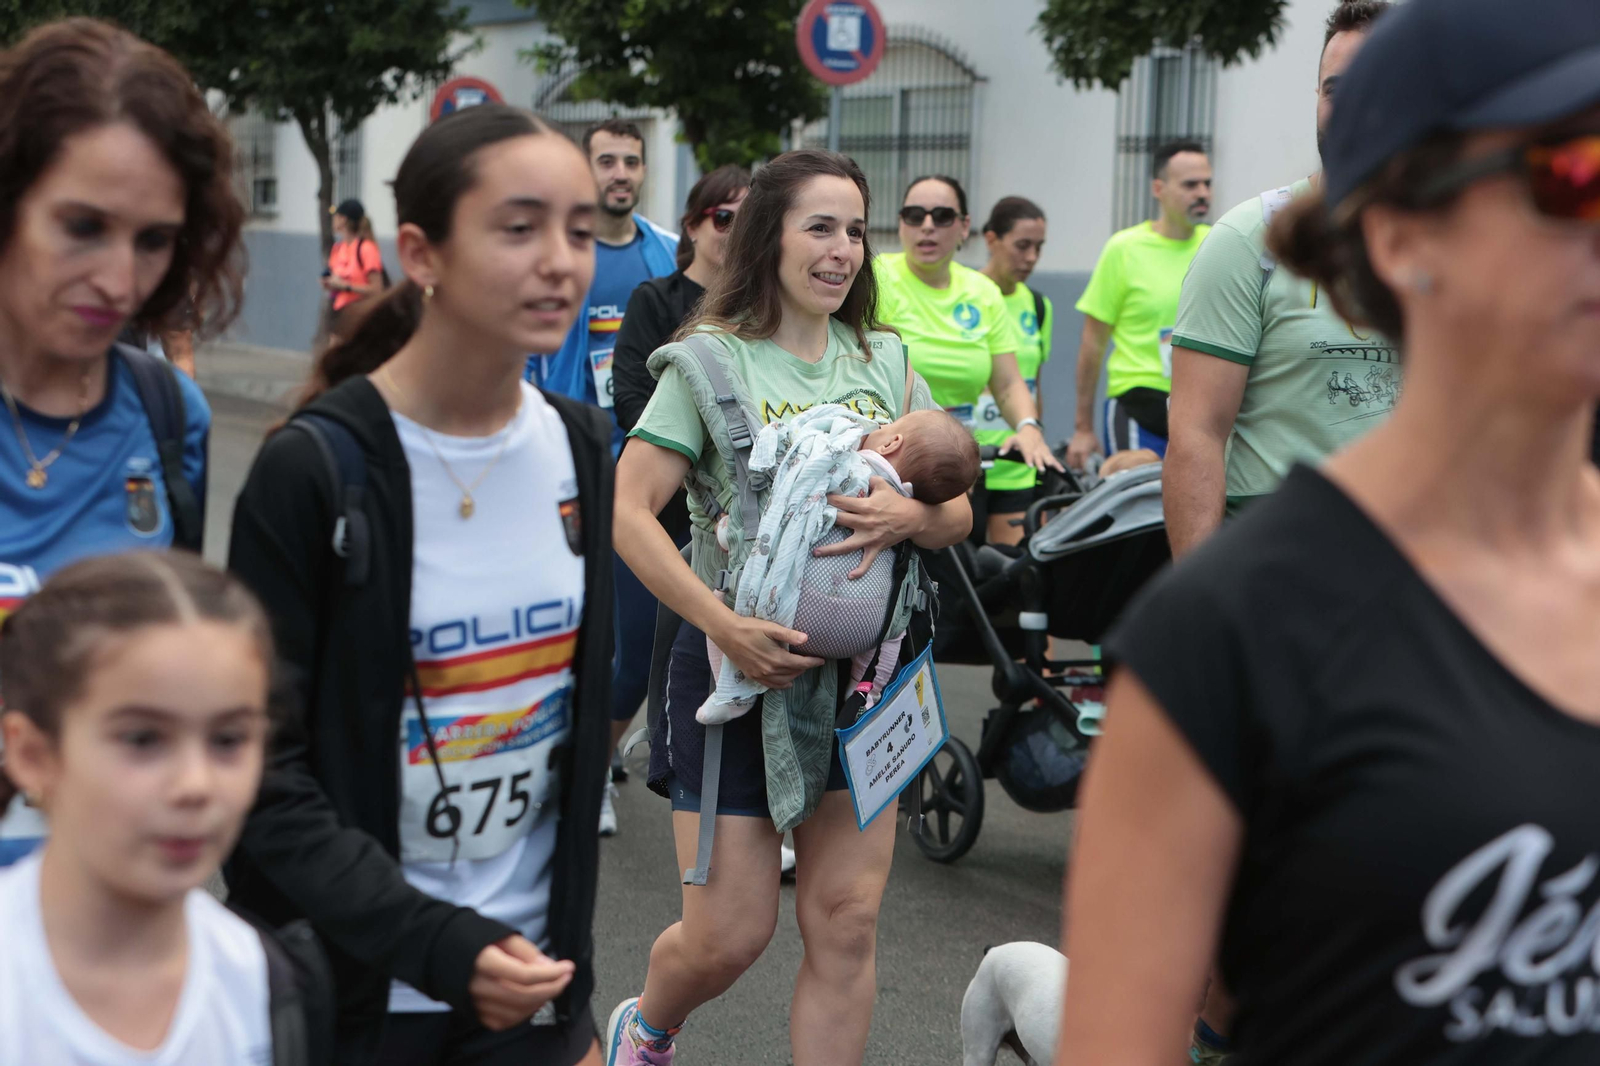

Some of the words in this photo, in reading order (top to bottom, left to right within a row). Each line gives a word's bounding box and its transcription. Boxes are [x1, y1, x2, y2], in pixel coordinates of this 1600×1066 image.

[1310, 341, 1327, 349] 2025
[866, 711, 906, 757] BABYRUNNER
[886, 741, 894, 753] 4
[869, 761, 892, 789] AMELIE
[885, 759, 906, 783] PEREA
[426, 770, 532, 839] 675
[1394, 821, 1600, 1008] Jé
[1443, 976, 1600, 1041] SALU
